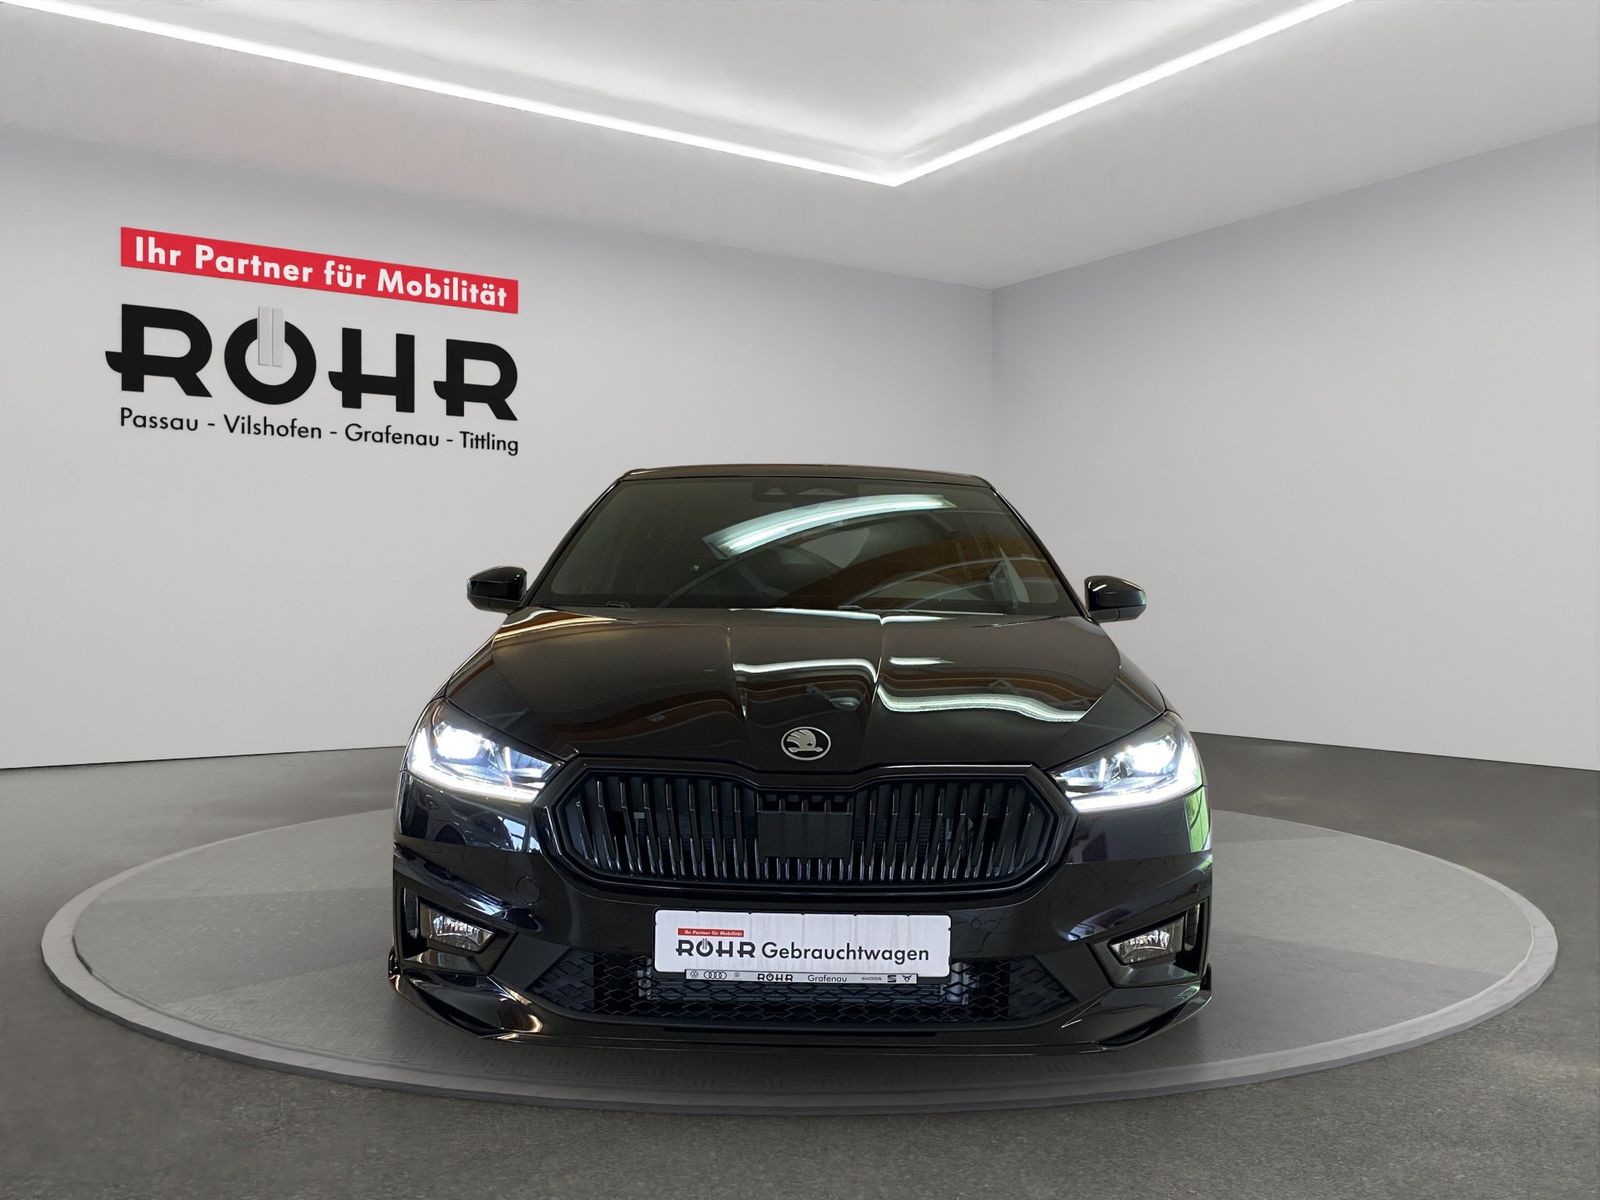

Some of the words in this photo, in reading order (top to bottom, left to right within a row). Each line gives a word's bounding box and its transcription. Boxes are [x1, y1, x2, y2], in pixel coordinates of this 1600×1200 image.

[135, 236, 182, 266] Ihr
[195, 243, 314, 283] Partner
[324, 260, 367, 289] für
[377, 268, 507, 307] Mobilität
[120, 406, 199, 432] Passau
[223, 413, 322, 440] Vilshofen
[344, 422, 440, 447] Grafenau
[459, 431, 519, 457] Tittling
[761, 941, 929, 965] Gebrauchtwagen
[807, 974, 848, 982] Grafenau
